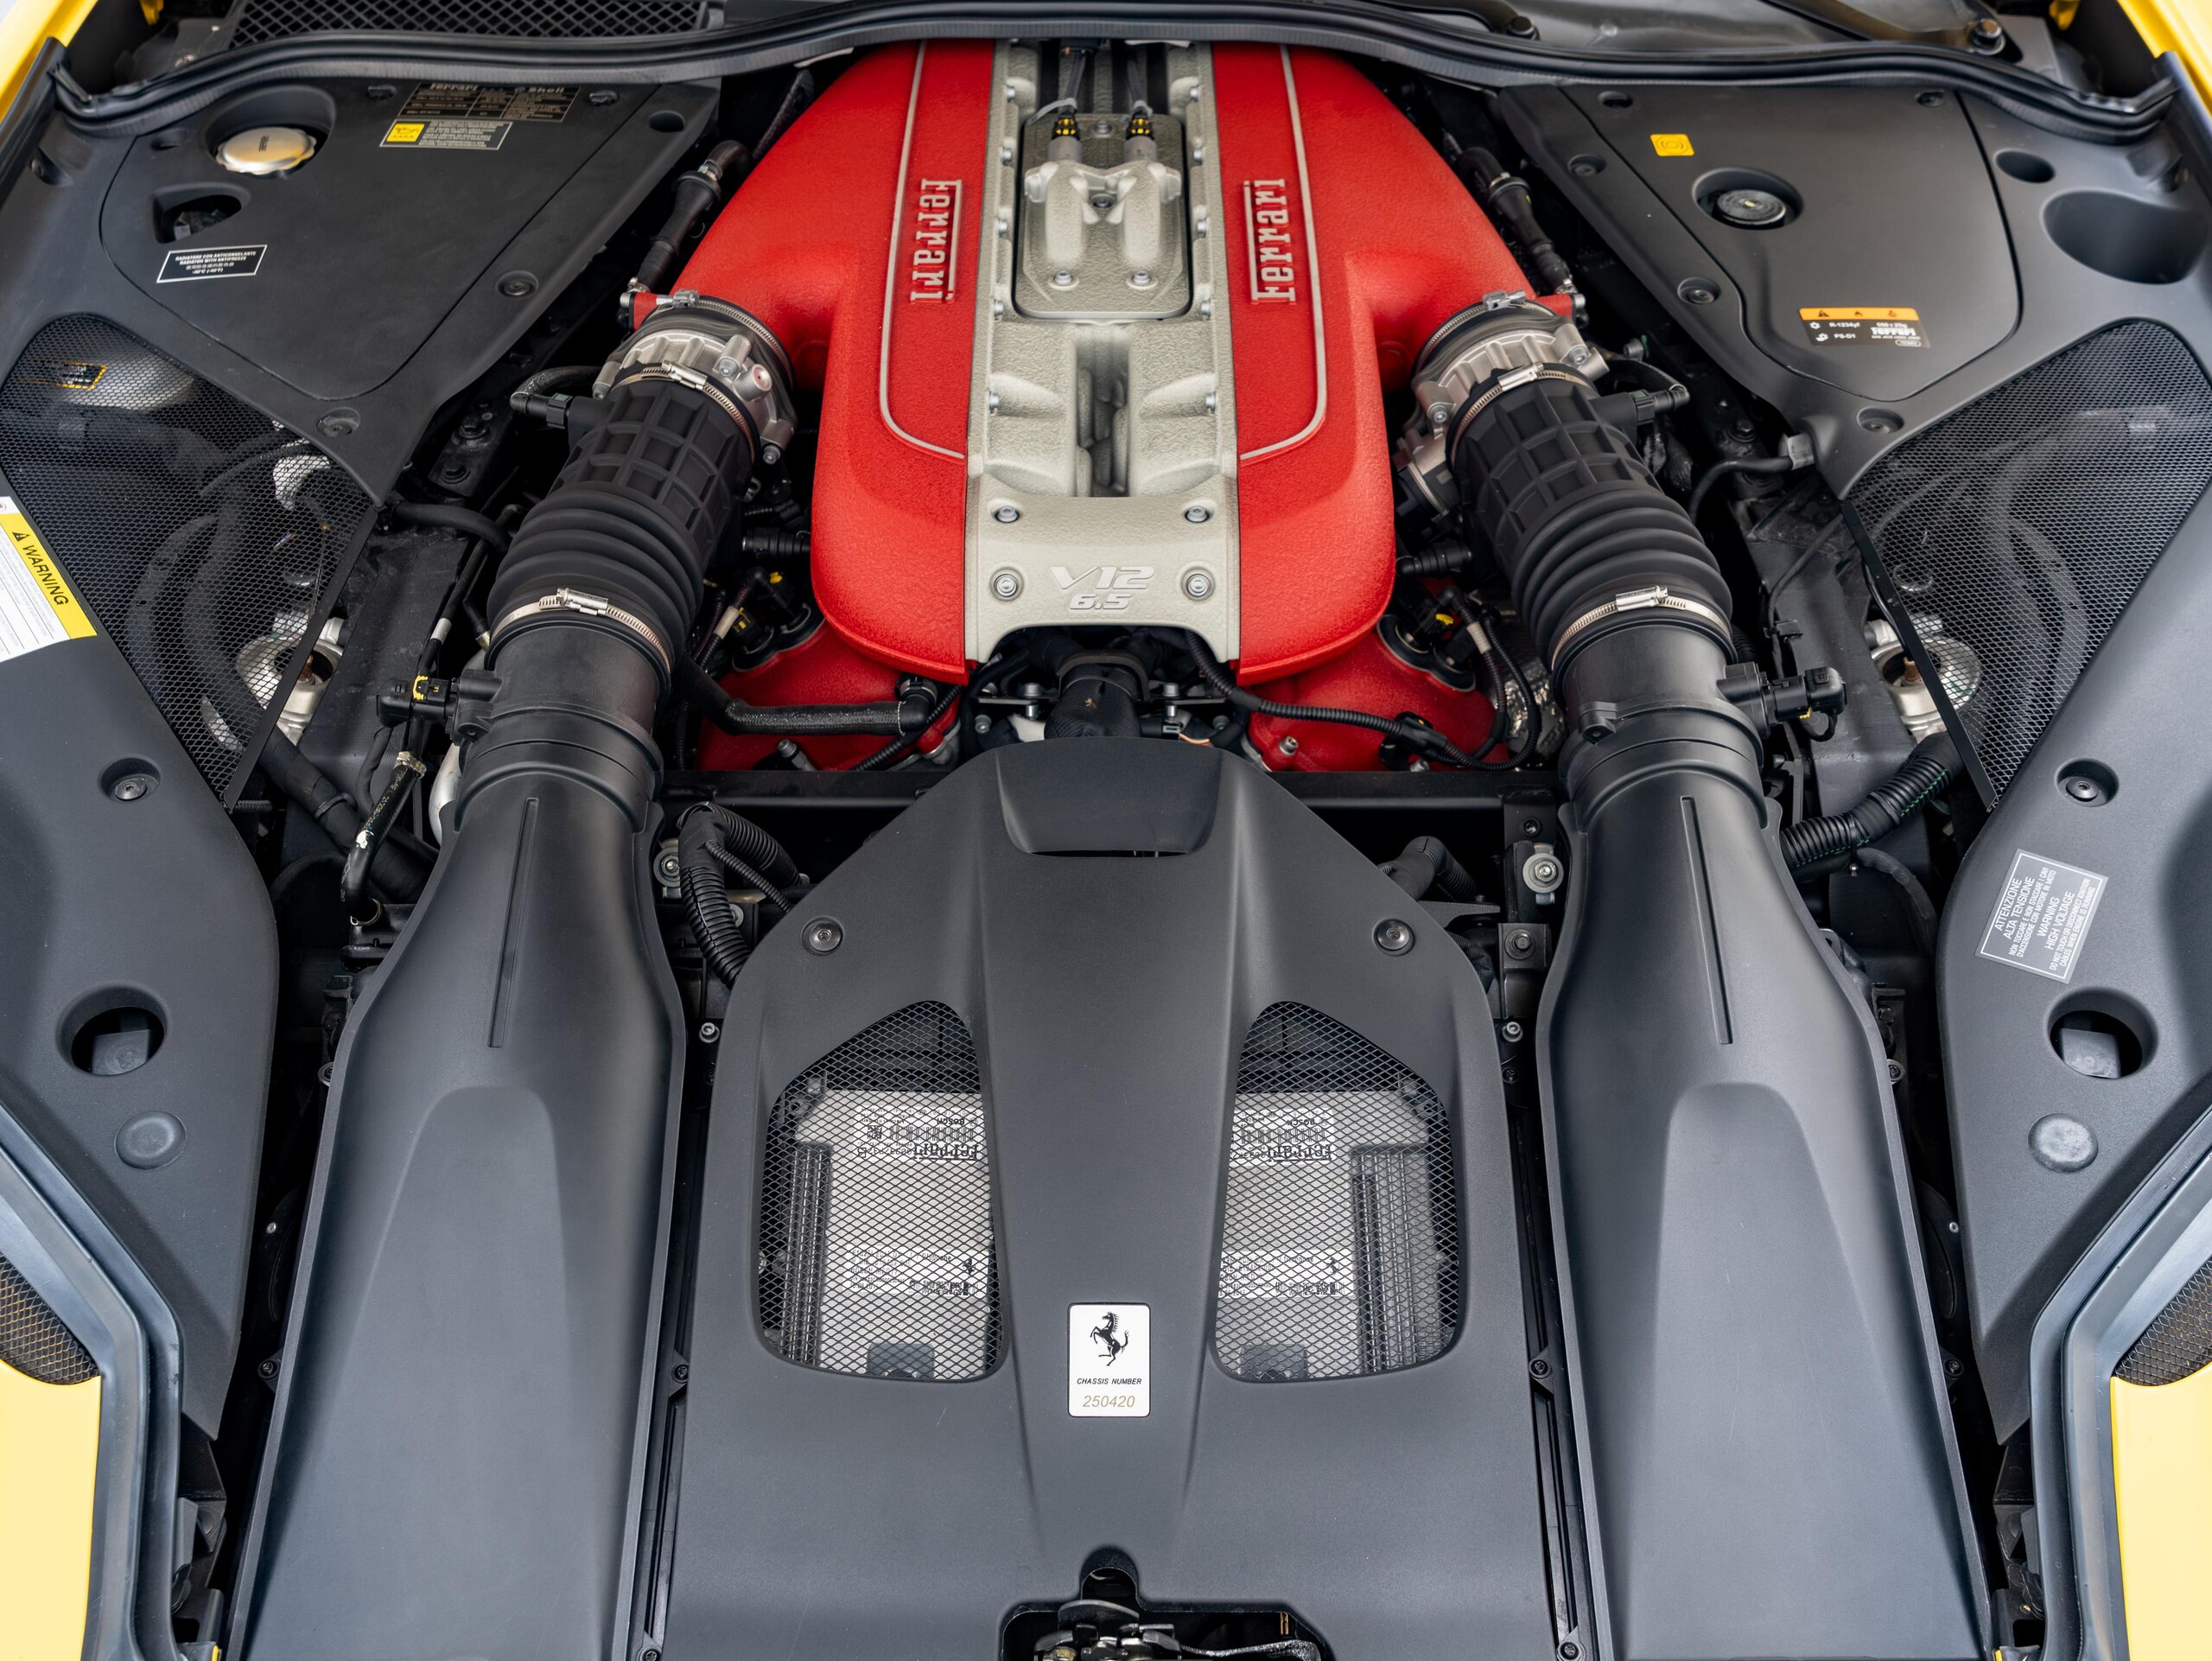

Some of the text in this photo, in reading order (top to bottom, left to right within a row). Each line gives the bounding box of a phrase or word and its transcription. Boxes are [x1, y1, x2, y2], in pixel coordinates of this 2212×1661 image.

[910, 178, 962, 302] Ferrari
[1243, 179, 1296, 302] Ferrari
[1871, 327, 1916, 336] Ferrari
[22, 544, 69, 606] WARNING
[1049, 566, 1155, 589] V12
[1069, 593, 1133, 610] 6.5
[2045, 869, 2057, 885] MOTO
[1993, 878, 2023, 932] ATTENZIONE
[2002, 876, 2036, 939] ALTA TENSIONE
[2008, 944, 2018, 956] NON
[2013, 921, 2028, 944] TOCCARE
[2024, 905, 2034, 917] NON
[2029, 881, 2044, 906] STACCARE
[2031, 912, 2040, 923] CON
[2035, 891, 2049, 912] MOTORE
[2037, 896, 2061, 938] WARNING
[2044, 891, 2075, 950] HIGH VOLTAGE
[2017, 923, 2036, 958] D'ACCENSIONE
[2050, 878, 2091, 971] DO NOT TOUCH OR DISCONNECT IGNITION
[2059, 948, 2073, 967] CABLES
[2067, 932, 2078, 949] WHEN
[2073, 914, 2085, 932] ENGINE
[2082, 887, 2096, 908] RUNNING
[913, 1142, 979, 1161] Ferrari
[1268, 1144, 1332, 1161] Ferrari
[1082, 1395, 1135, 1408] 250420
